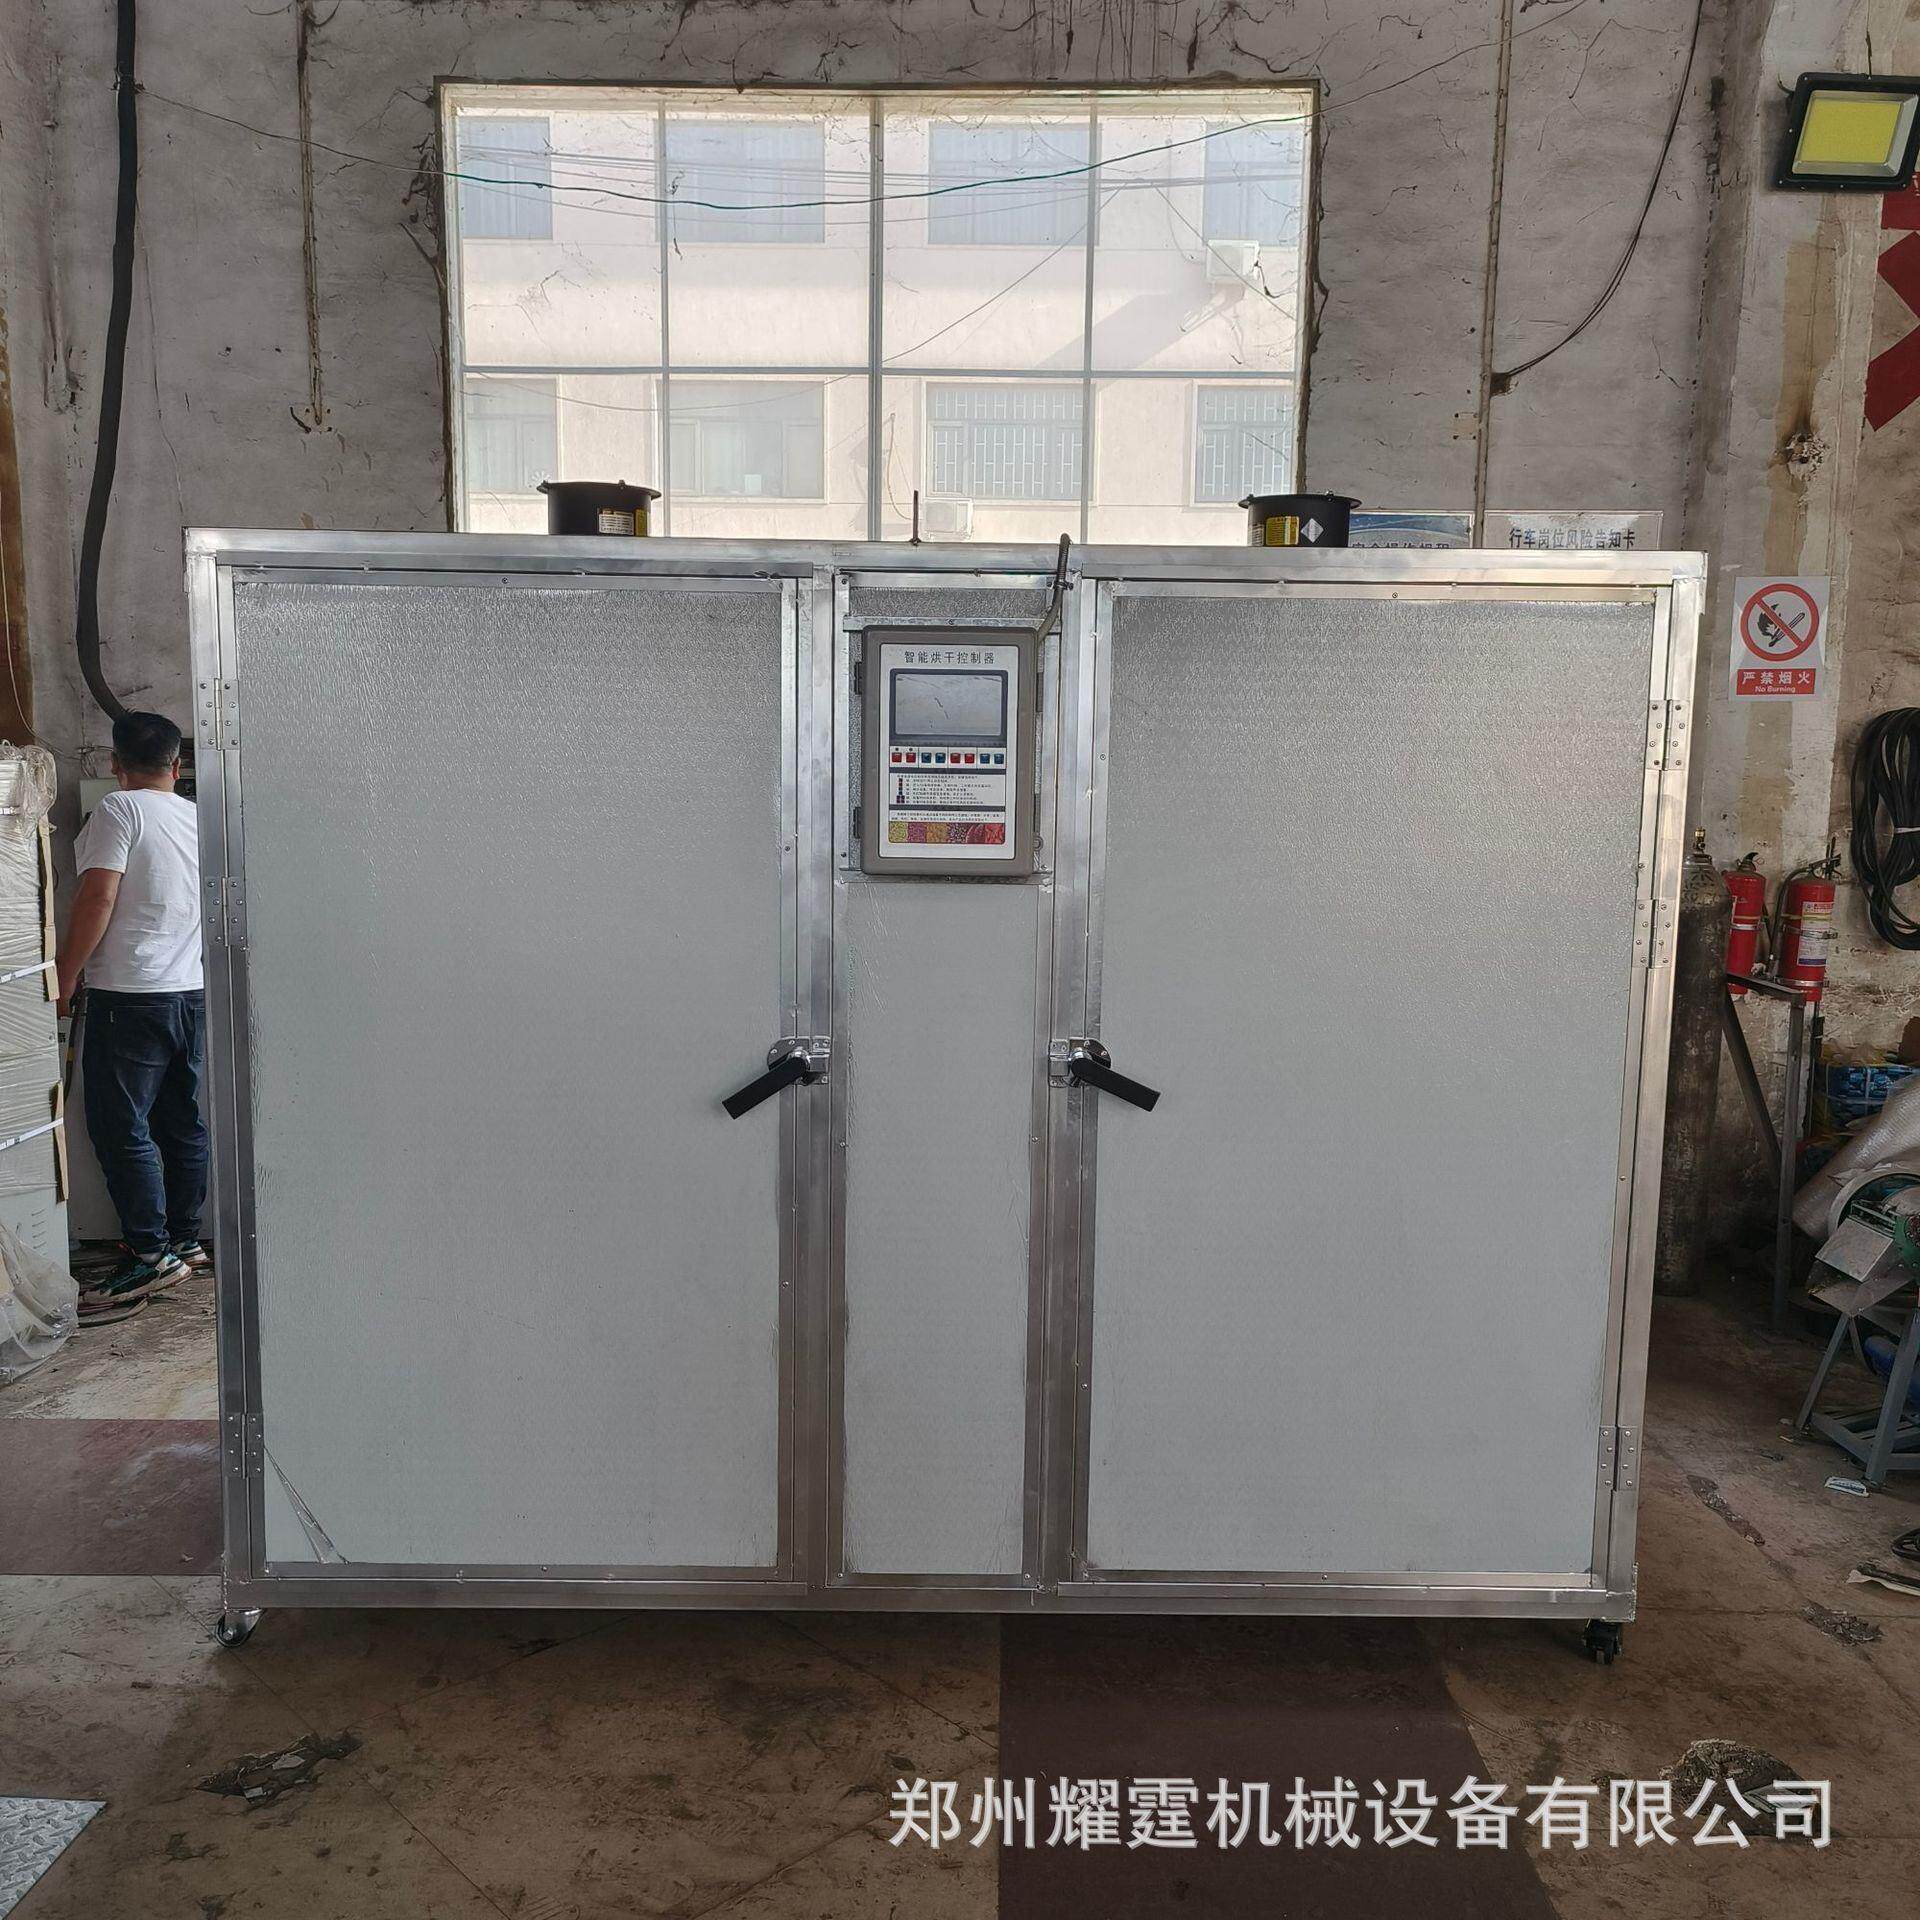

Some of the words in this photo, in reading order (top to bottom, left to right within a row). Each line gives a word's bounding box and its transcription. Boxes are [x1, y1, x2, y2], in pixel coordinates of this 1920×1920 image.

[1508, 527, 1636, 549] 行车岗位风险告知卡
[904, 650, 995, 665] 智能烘干控制器
[1742, 671, 1811, 685] 严禁烟火
[1767, 685, 1796, 693] Burning
